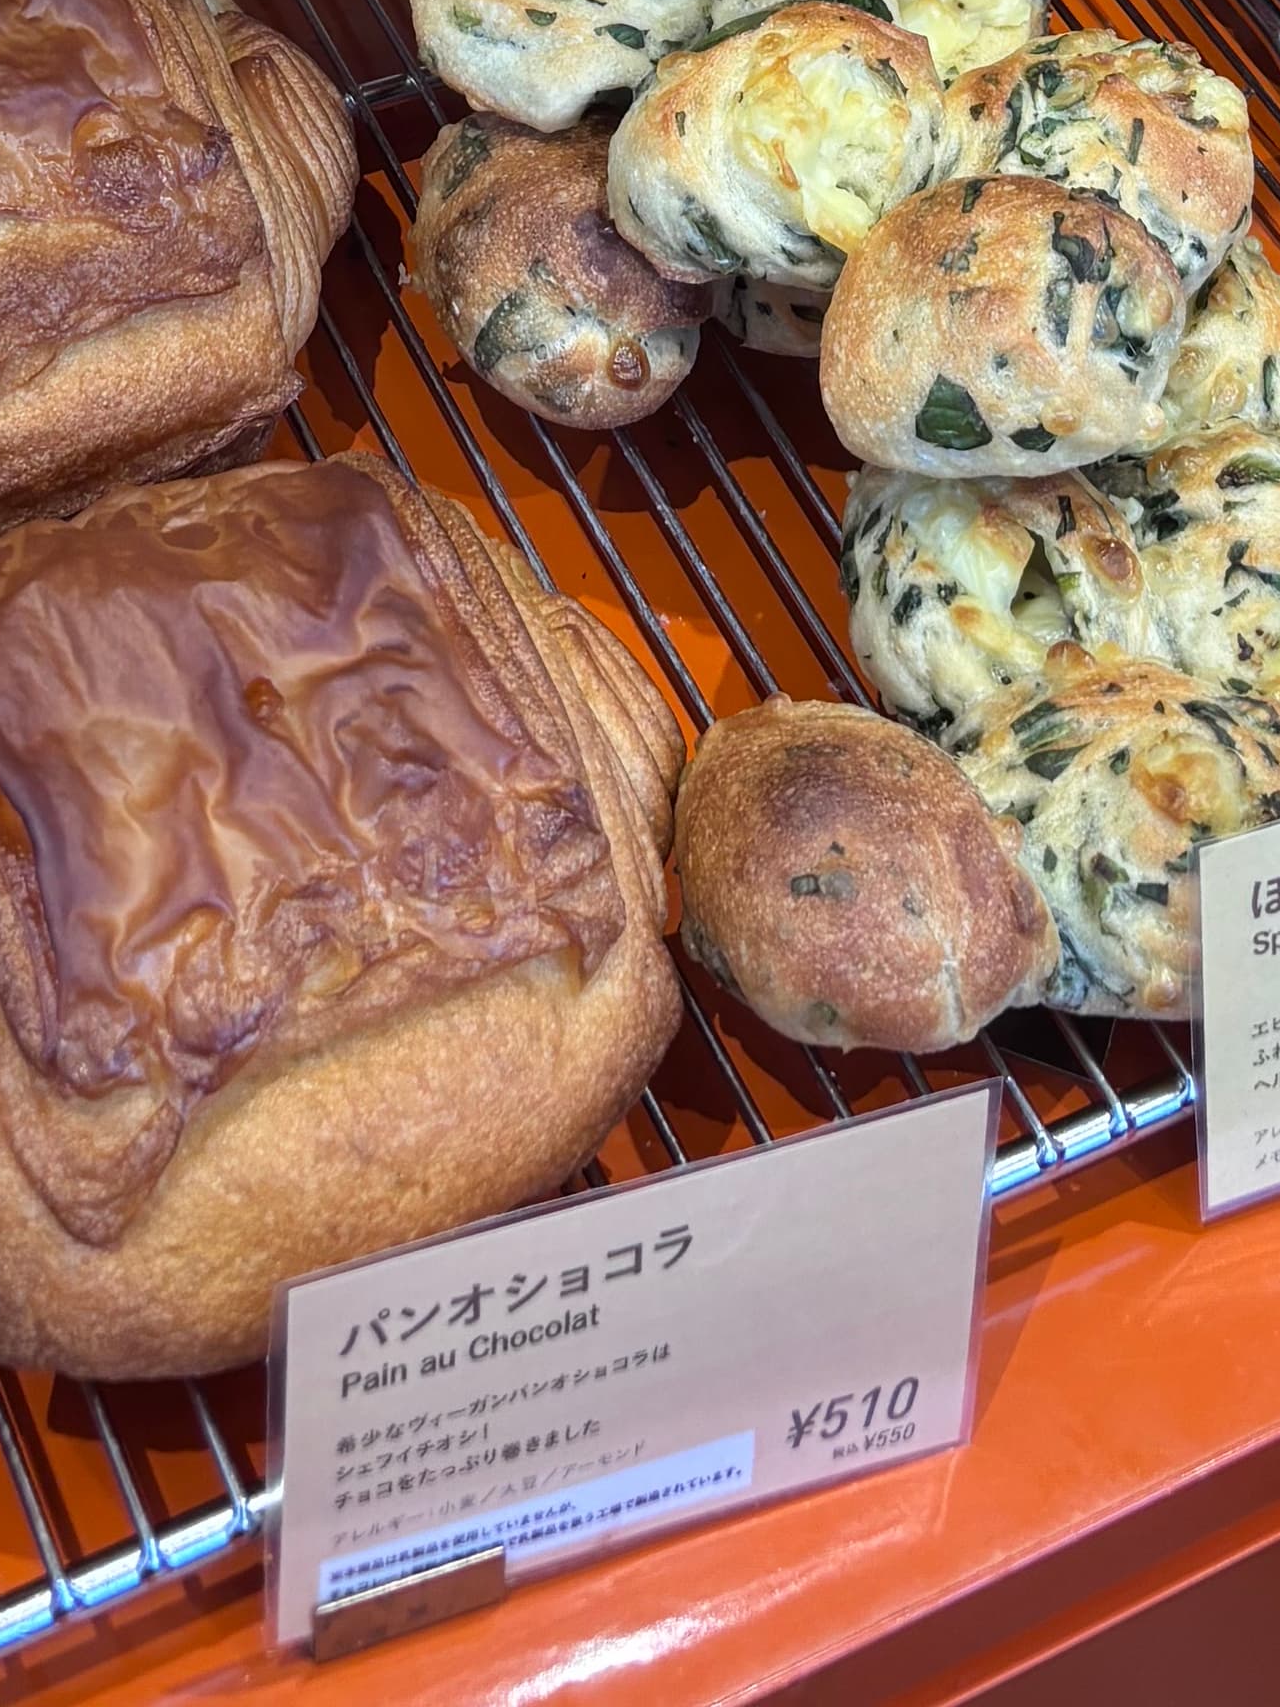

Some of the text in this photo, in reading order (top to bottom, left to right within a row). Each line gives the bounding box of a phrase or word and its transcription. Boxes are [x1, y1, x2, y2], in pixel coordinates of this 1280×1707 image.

[339, 1222, 696, 1357] パンオショコラ
[341, 1303, 601, 1399] Pain au Chocolat
[784, 1376, 920, 1452] ¥510
